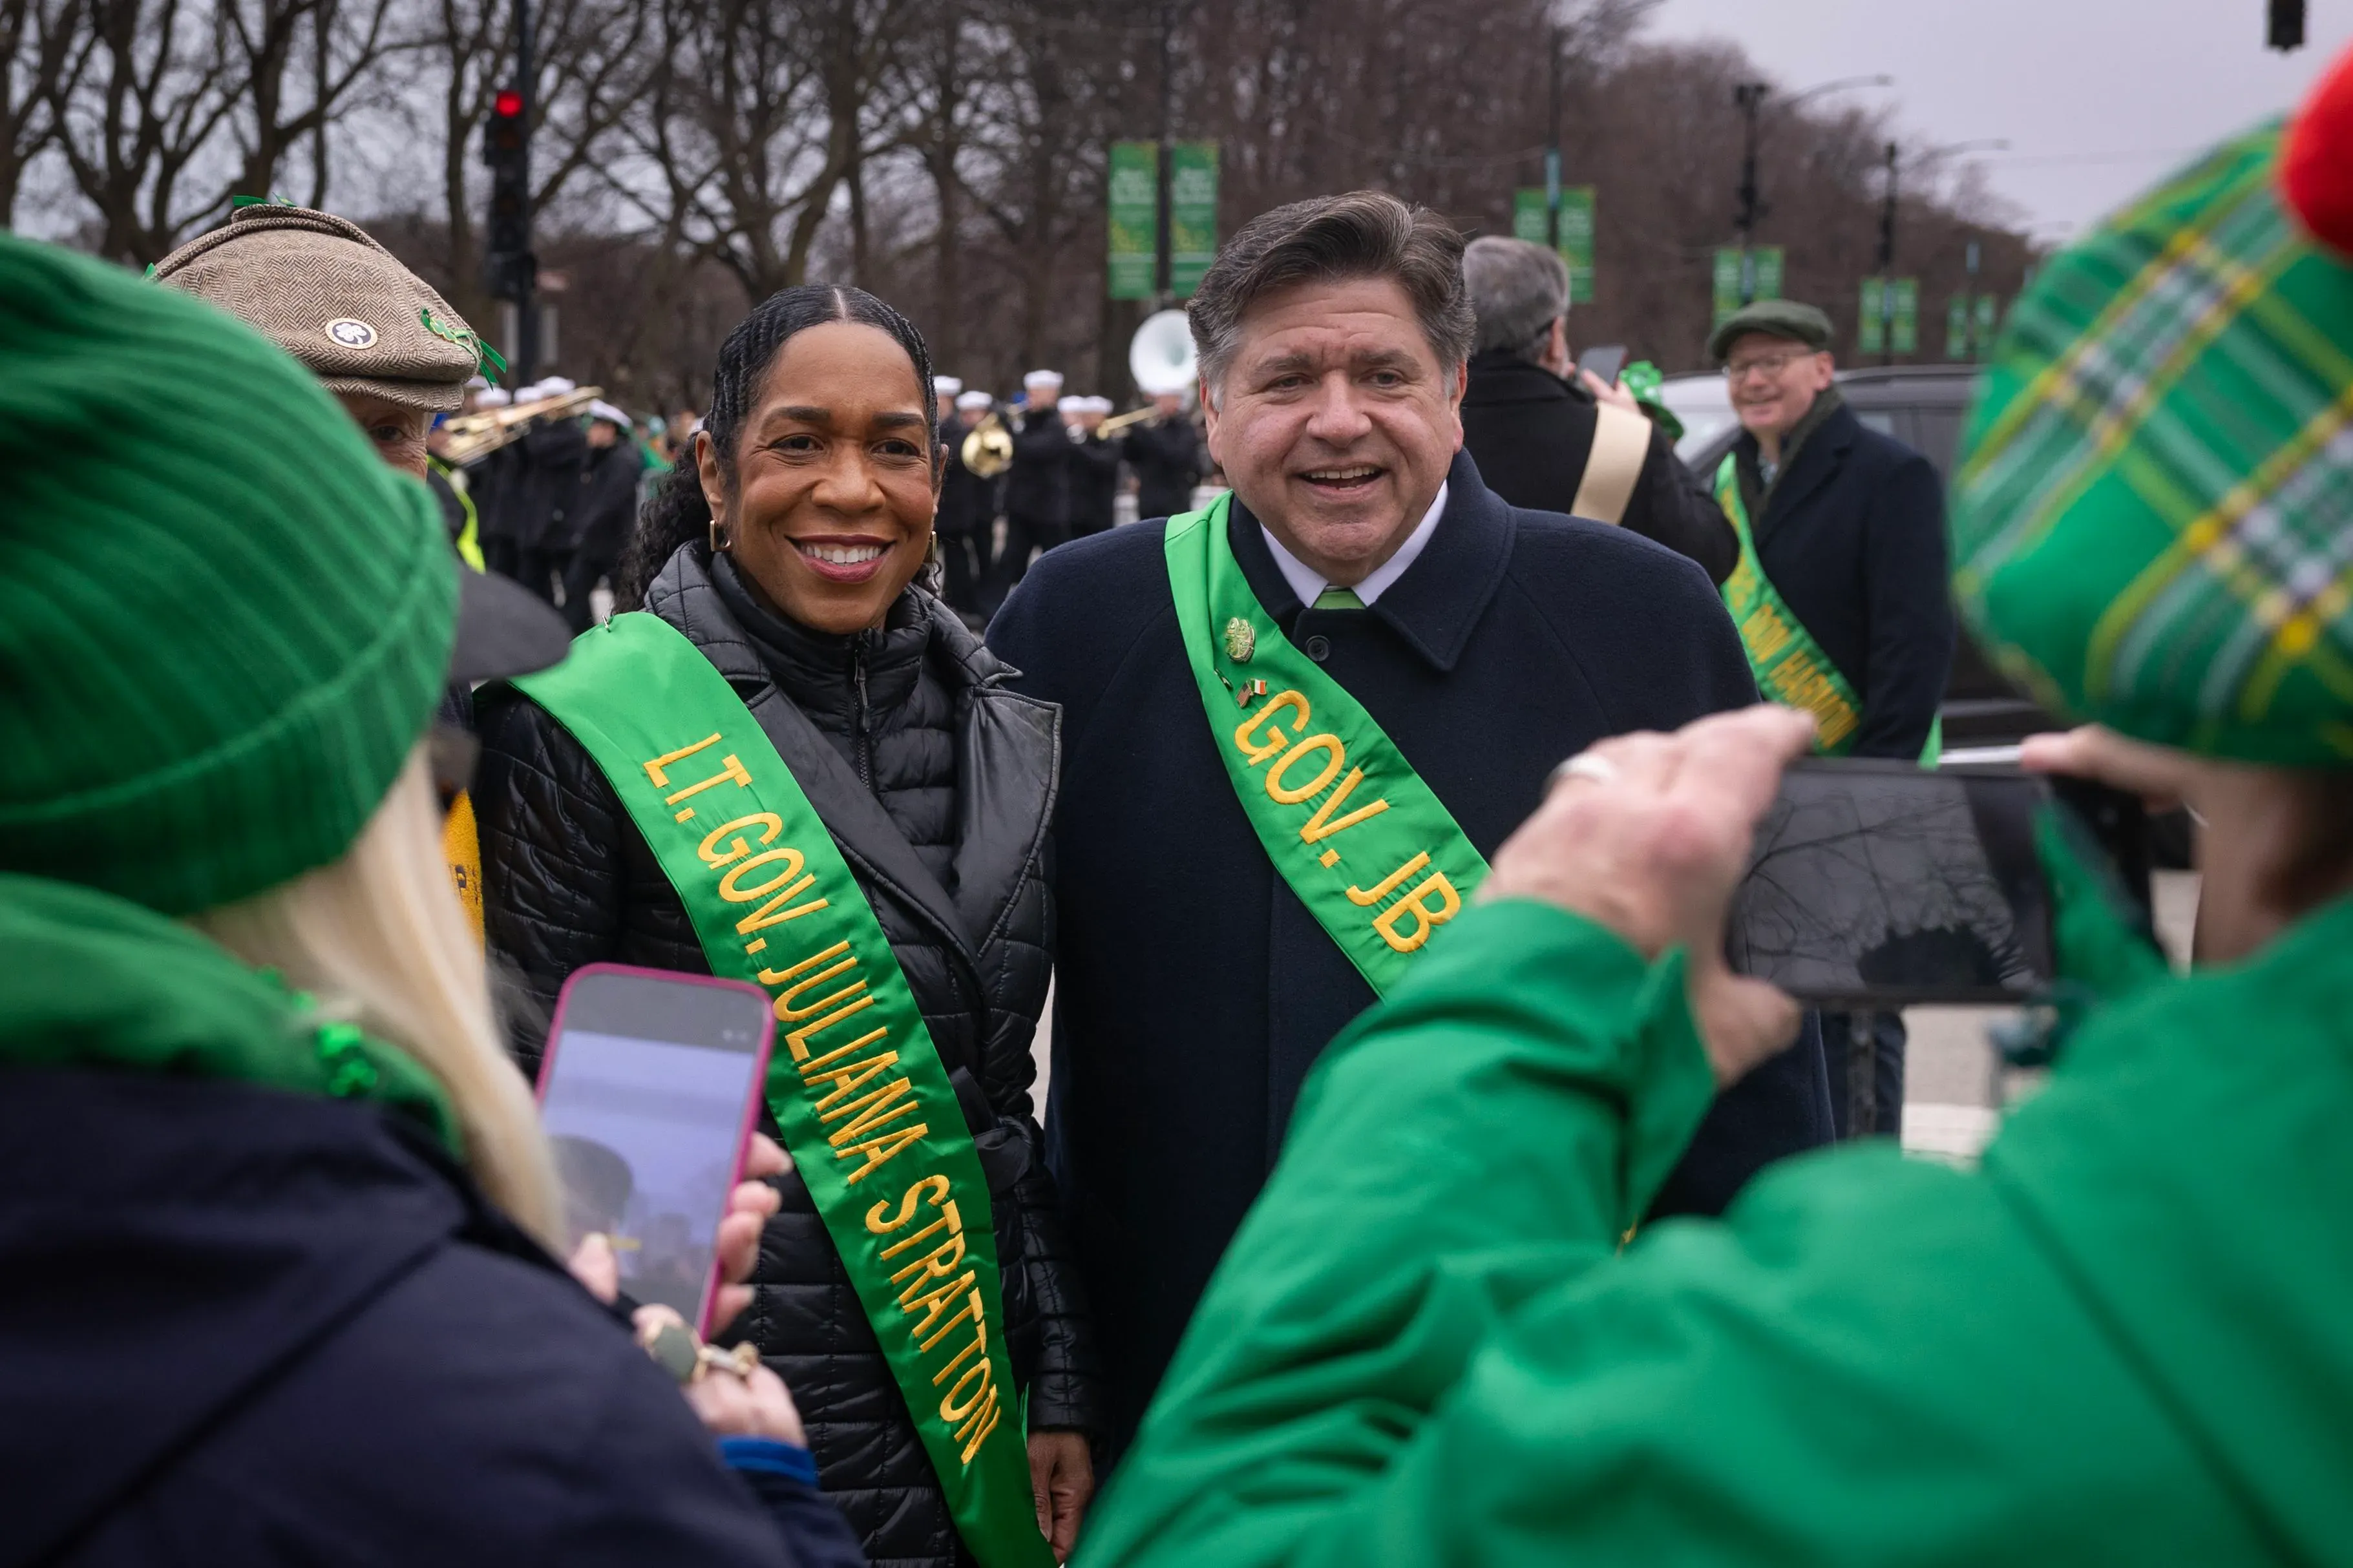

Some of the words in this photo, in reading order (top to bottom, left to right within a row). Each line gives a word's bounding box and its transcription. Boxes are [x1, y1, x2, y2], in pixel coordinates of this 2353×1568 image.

[644, 732, 753, 824] LT.
[697, 811, 830, 954] GOV.
[1234, 689, 1390, 869] GOV.
[1345, 850, 1461, 954] JB
[757, 939, 929, 1186] JULIANA
[865, 1174, 1002, 1465] STRATTON
